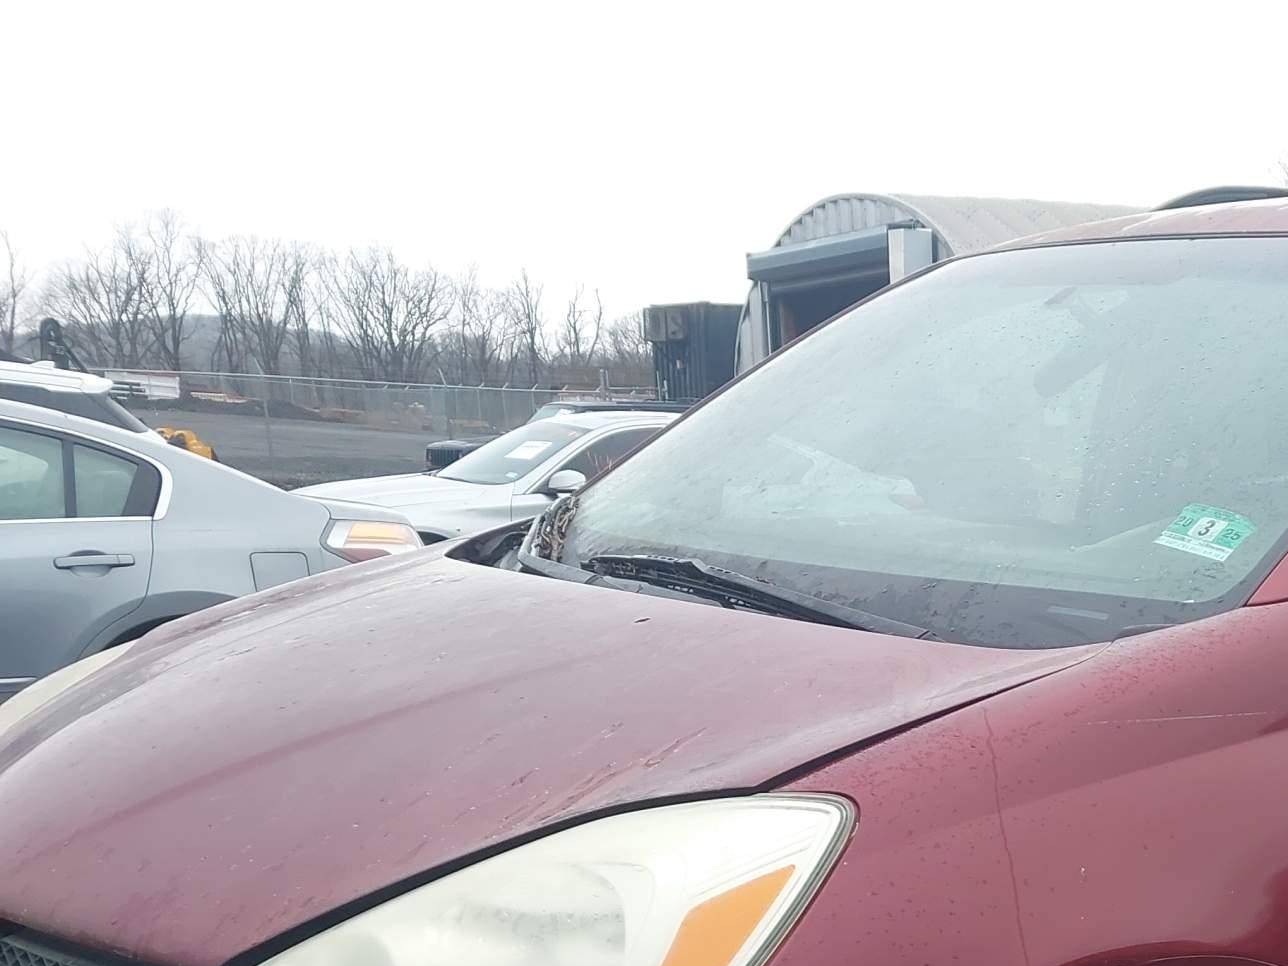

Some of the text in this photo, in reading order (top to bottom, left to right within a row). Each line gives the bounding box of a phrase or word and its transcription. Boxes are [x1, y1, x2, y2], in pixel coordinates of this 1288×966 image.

[1174, 515, 1241, 541] 20 3 25
